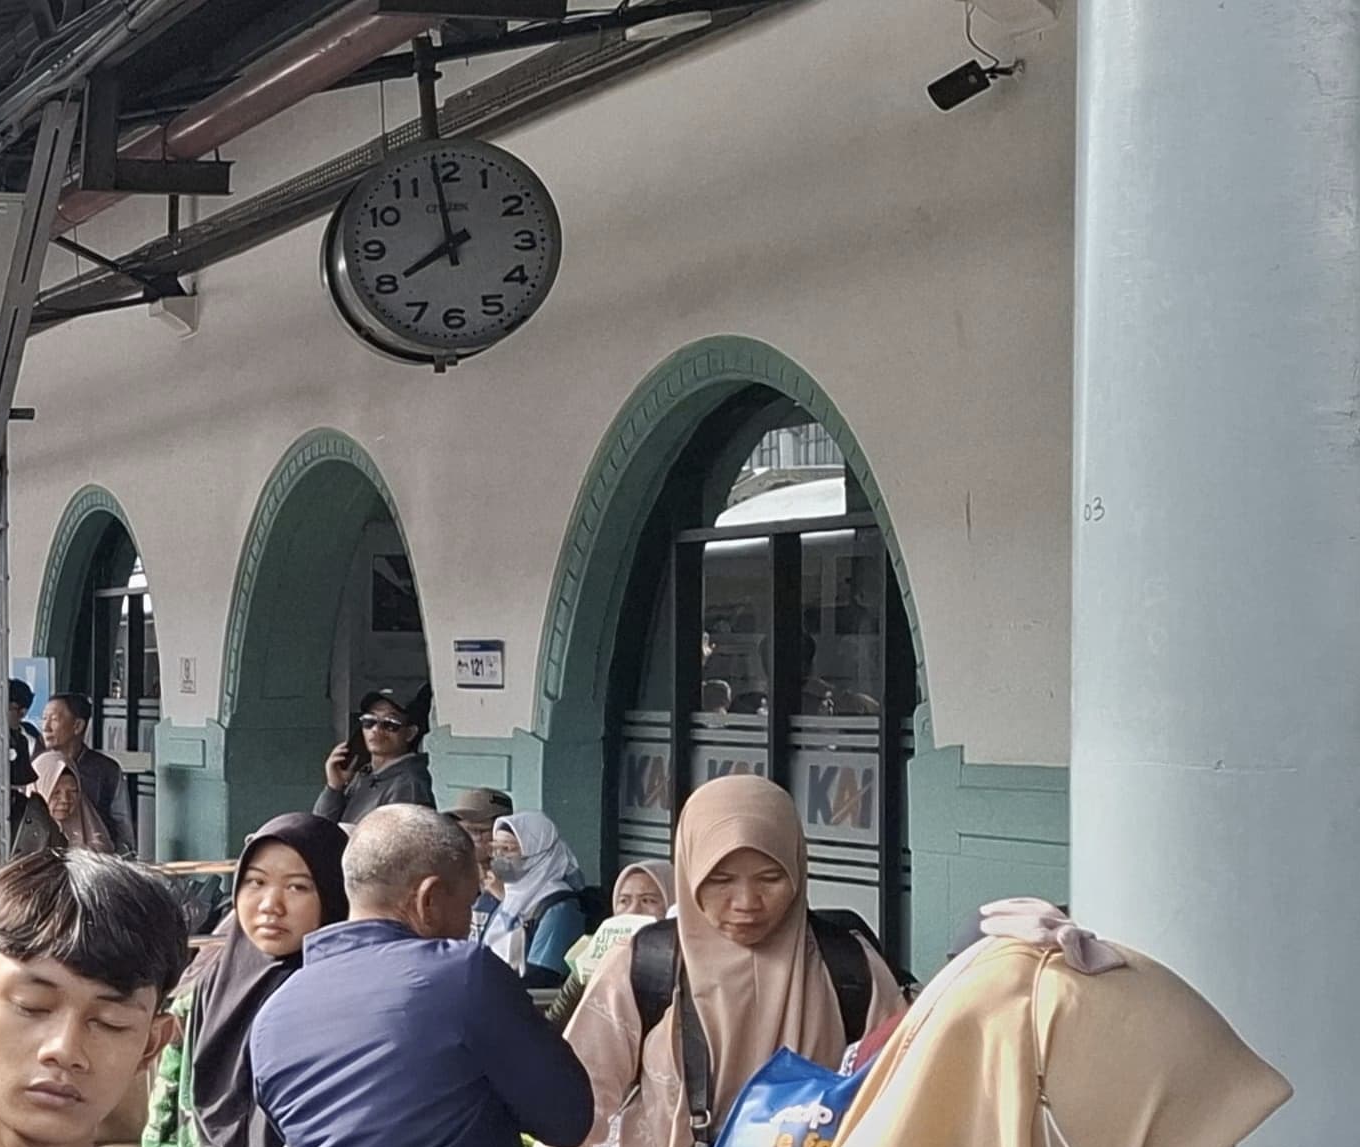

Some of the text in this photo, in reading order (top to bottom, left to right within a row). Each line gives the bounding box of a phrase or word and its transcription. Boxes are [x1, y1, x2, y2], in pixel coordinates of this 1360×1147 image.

[392, 178, 420, 199] 11
[479, 169, 489, 190] 1
[370, 206, 401, 228] 10
[501, 195, 525, 217] 2
[362, 239, 387, 261] 9
[513, 230, 537, 251] 3
[374, 274, 399, 294] 8
[503, 264, 529, 285] 4
[405, 301, 429, 323] 7
[481, 294, 505, 316] 5
[441, 308, 466, 330] 6
[806, 763, 875, 830] KAI
